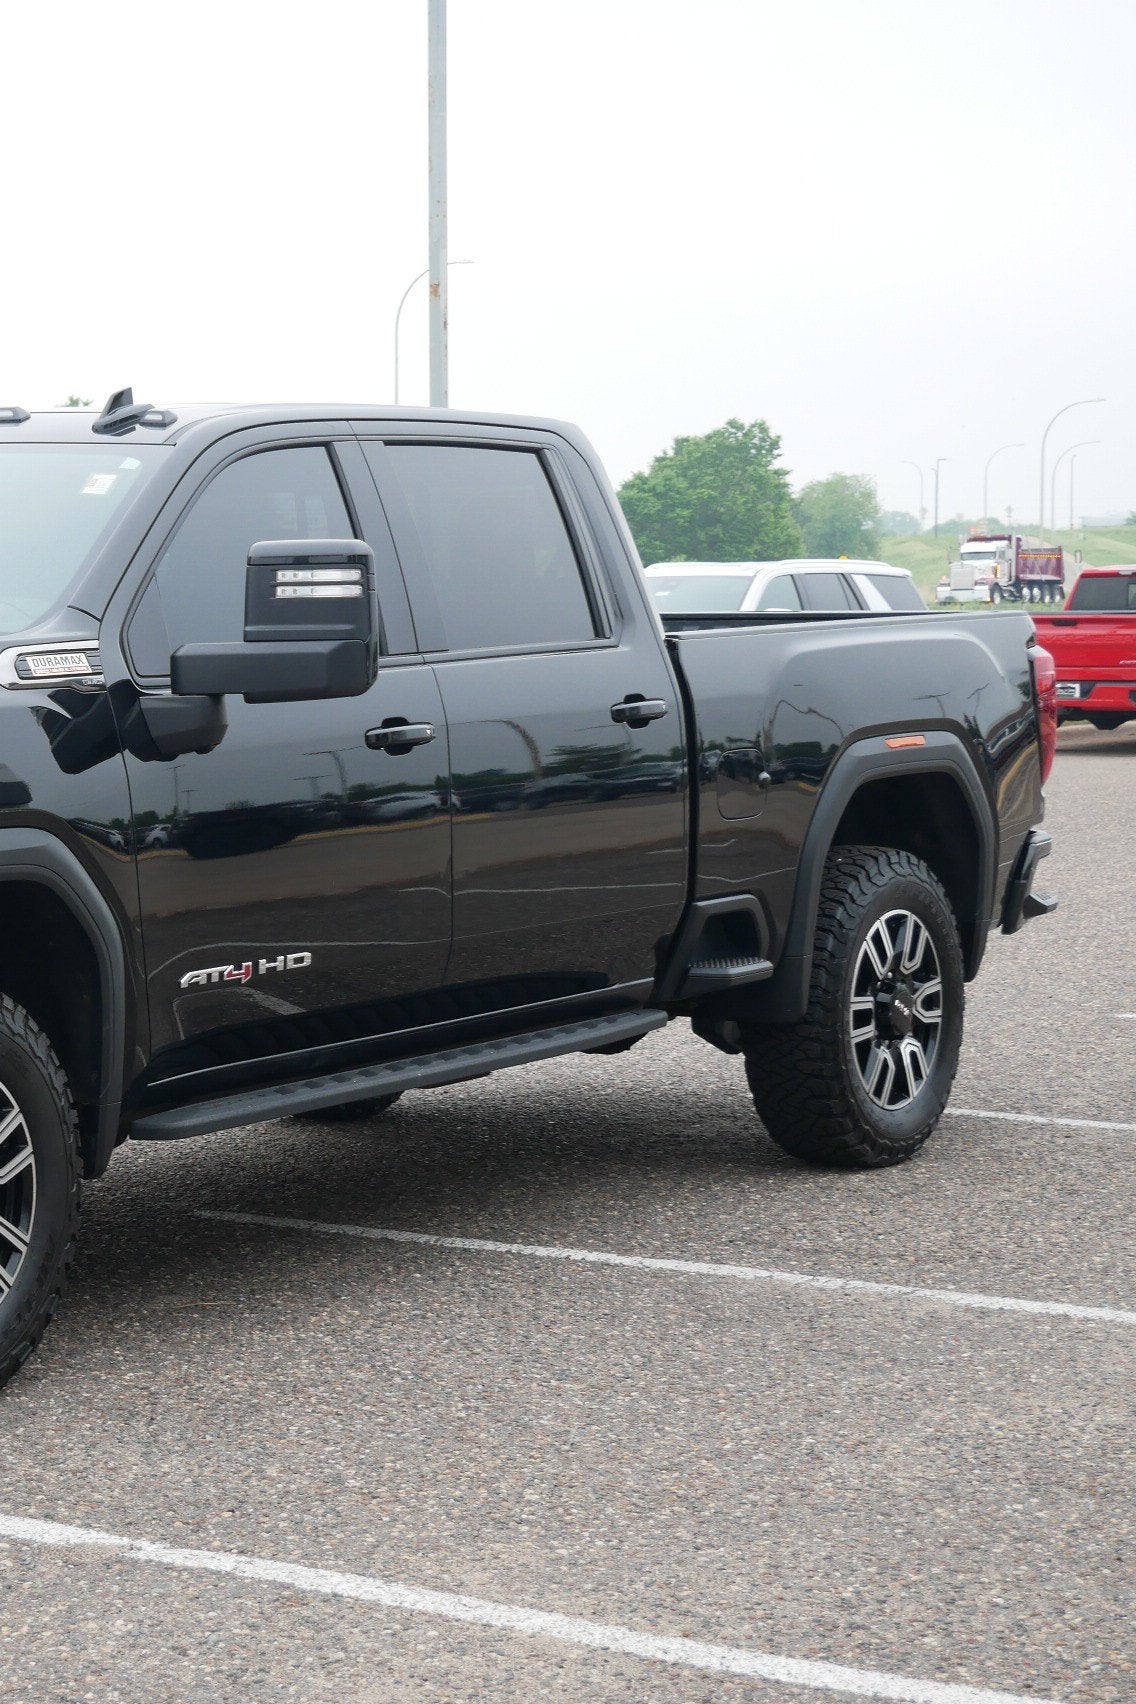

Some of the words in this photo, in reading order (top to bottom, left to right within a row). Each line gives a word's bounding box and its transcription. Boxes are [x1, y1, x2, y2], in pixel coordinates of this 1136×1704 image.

[31, 654, 85, 668] DURAMAX
[179, 962, 252, 988] AT4
[258, 952, 312, 974] HD
